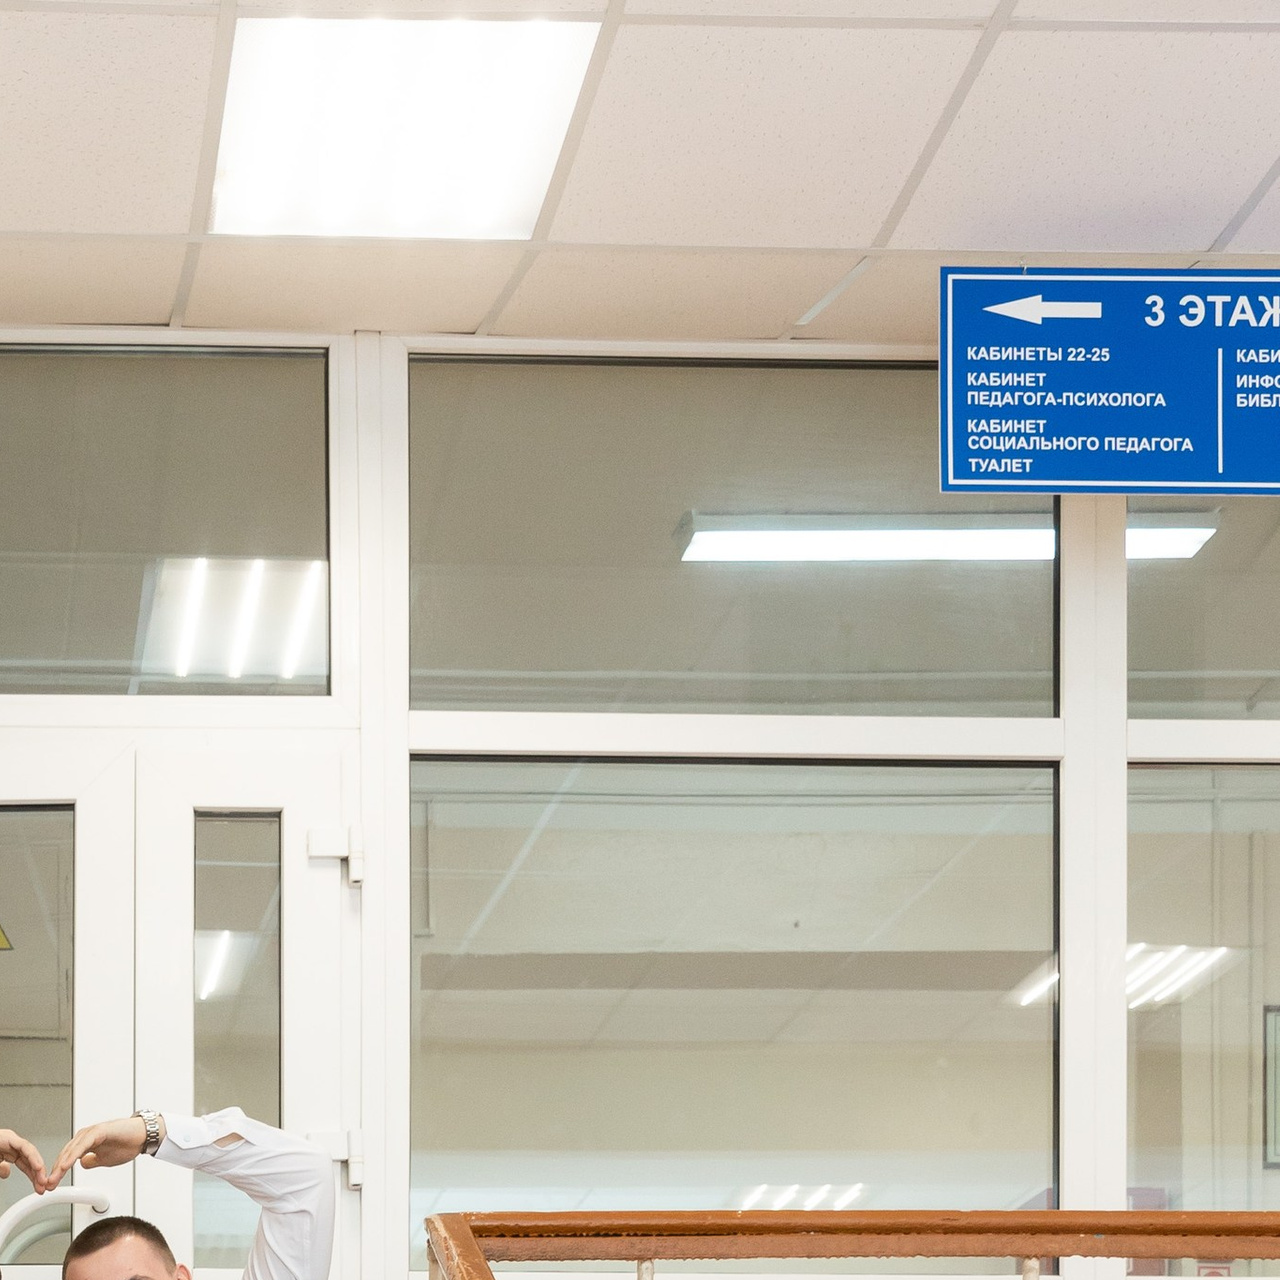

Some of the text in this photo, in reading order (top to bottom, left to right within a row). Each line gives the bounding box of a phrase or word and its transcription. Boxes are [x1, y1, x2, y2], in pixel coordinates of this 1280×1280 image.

[1144, 294, 1166, 328] 3
[967, 346, 1110, 362] КАБИНЕТЫ 22-25
[1236, 348, 1280, 363] КАБИ
[967, 372, 1047, 387] КАБИНЕТ
[967, 390, 1167, 408] ПЕДАГОГА-ПСИХОЛОГА
[967, 419, 1047, 434] КАБИНЕТ
[967, 435, 1194, 454] СОЦИАЛЬНОГО ПЕДАГОГА
[968, 458, 1034, 473] ТУАЛЕТ
